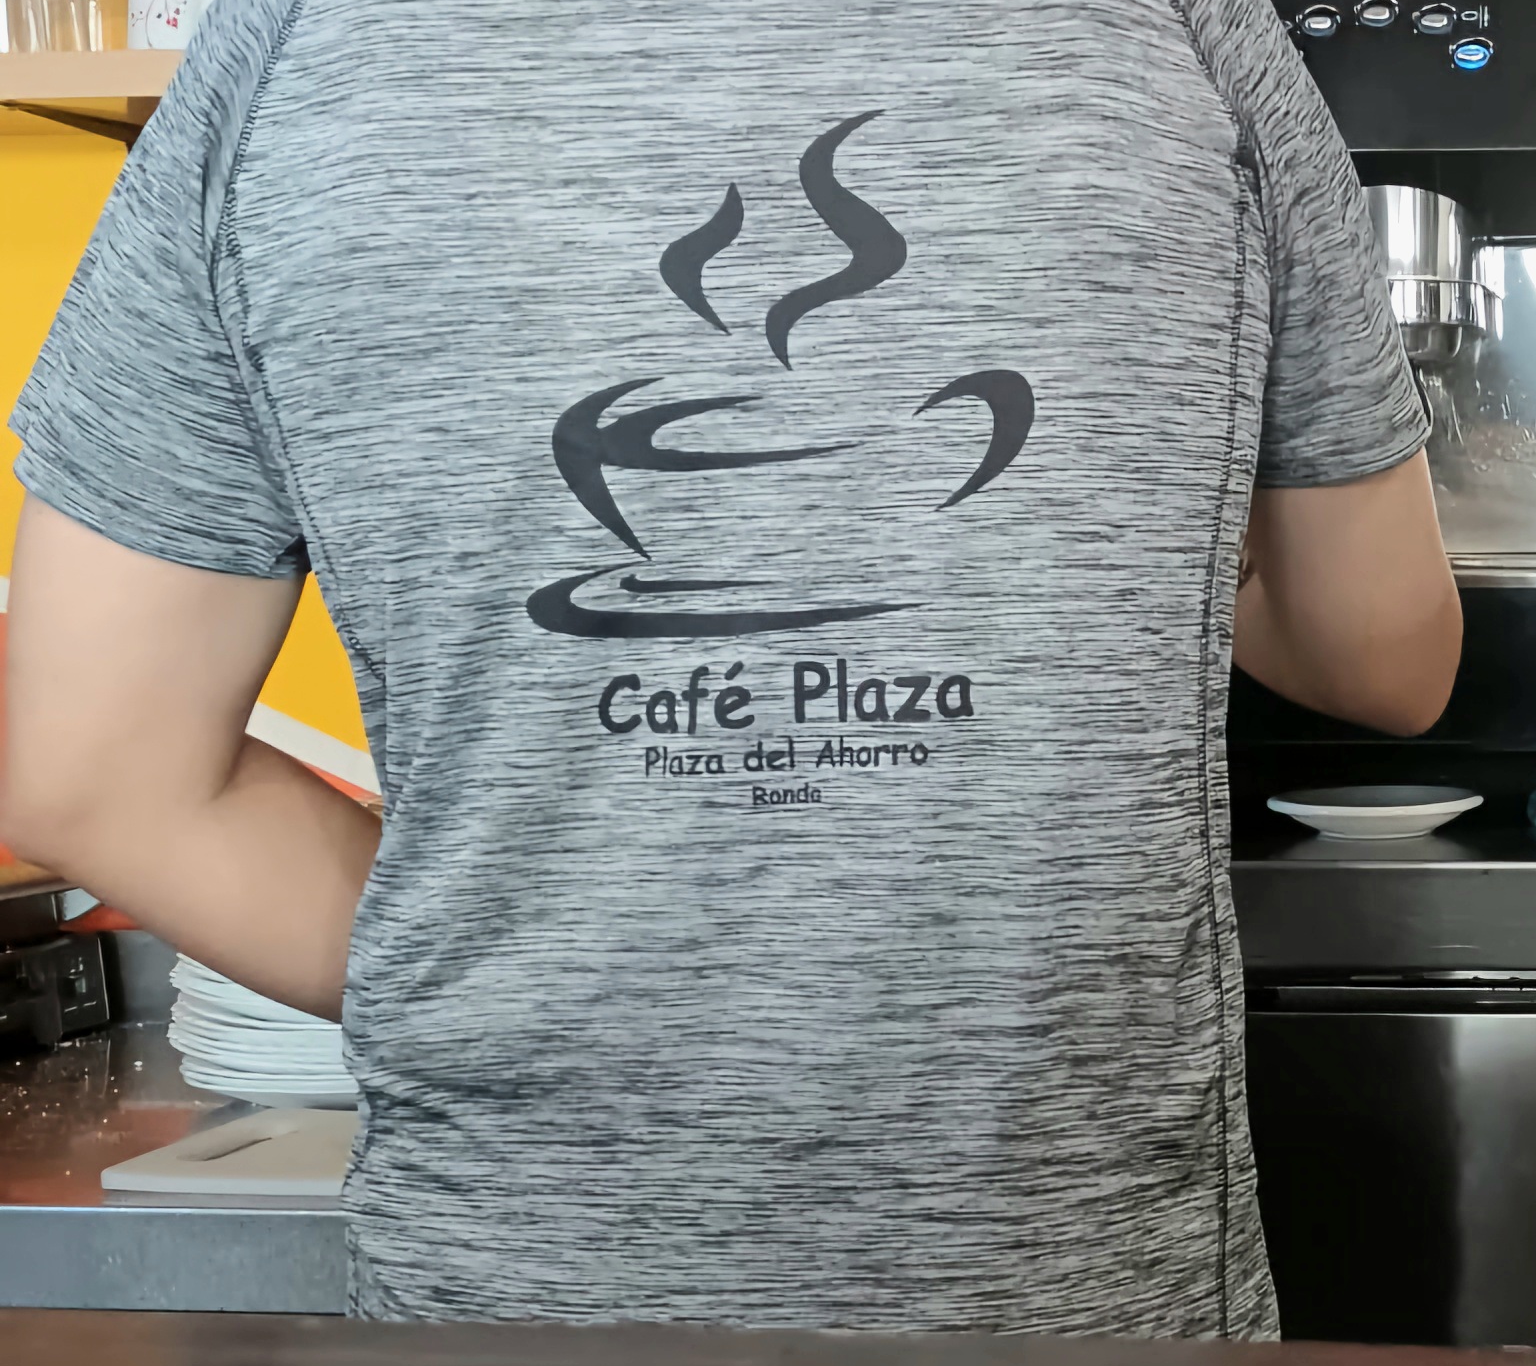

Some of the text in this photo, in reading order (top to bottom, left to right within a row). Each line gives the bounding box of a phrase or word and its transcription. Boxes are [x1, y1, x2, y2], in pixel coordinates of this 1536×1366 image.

[599, 659, 975, 735] Café Plaza
[645, 736, 930, 777] Plaza del Ahorro
[752, 782, 822, 807] Ronda
